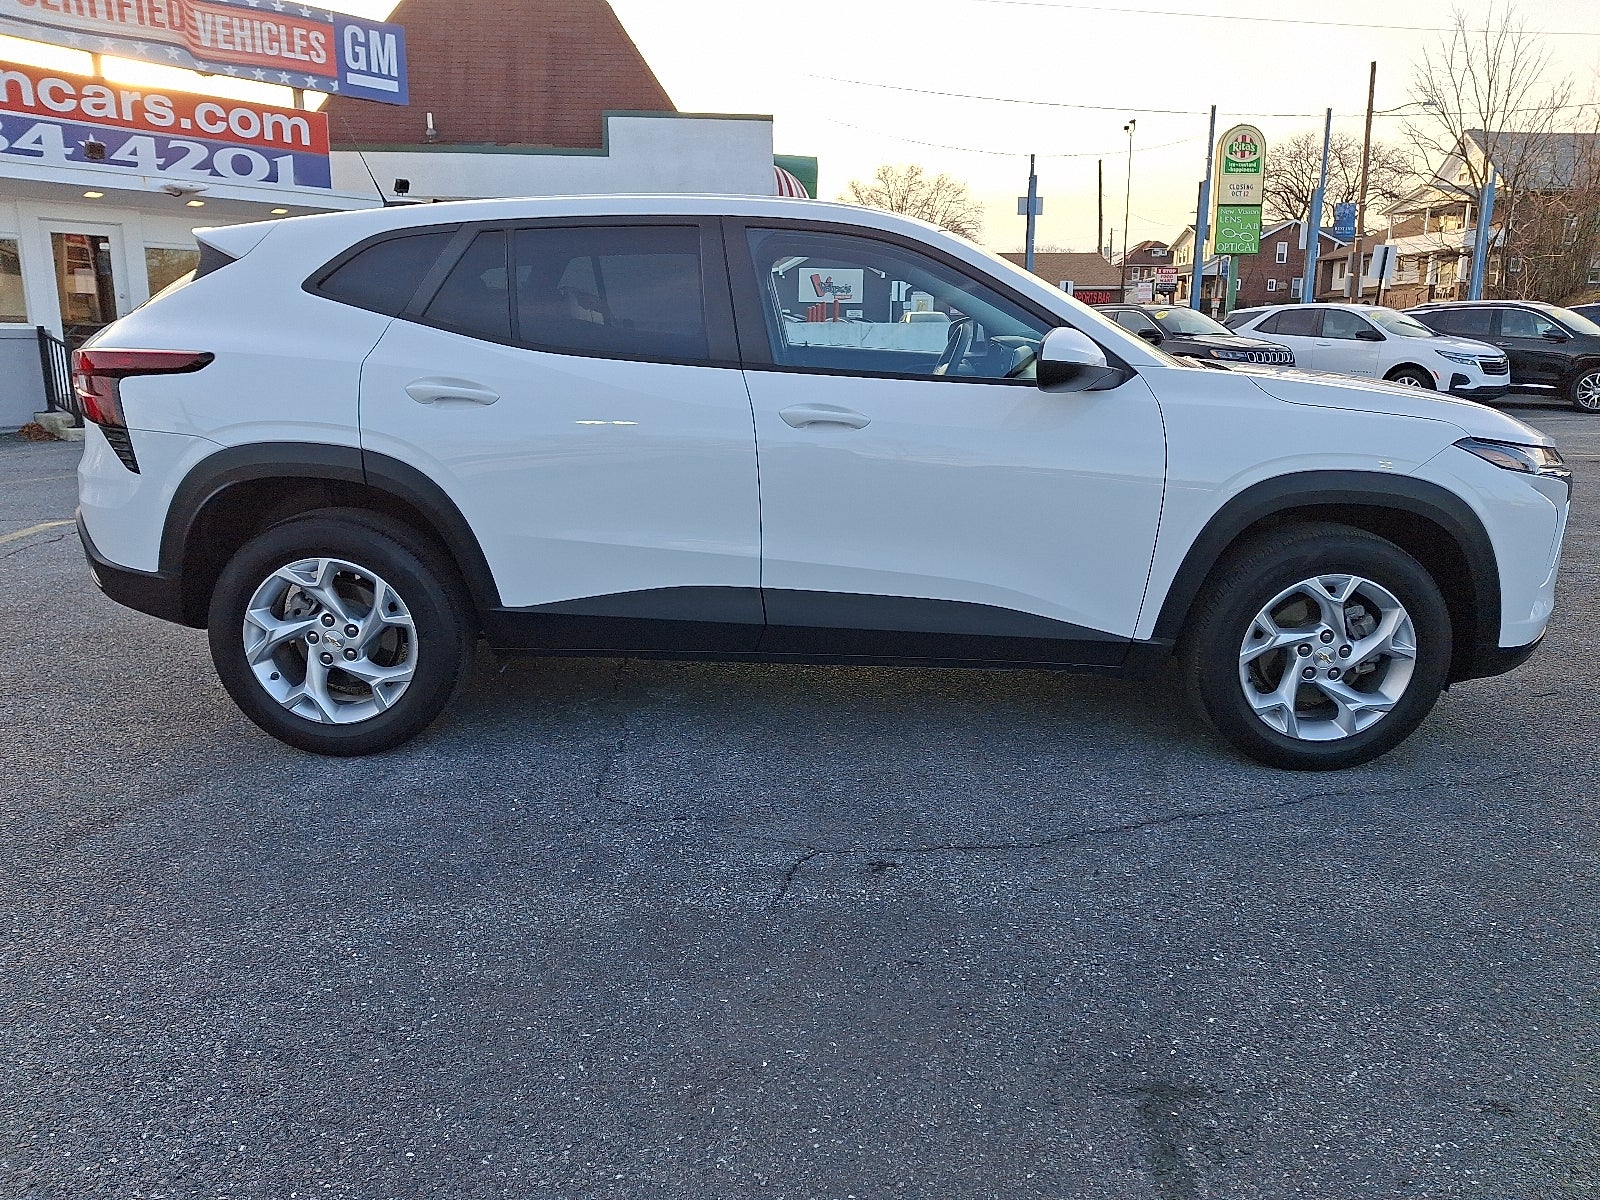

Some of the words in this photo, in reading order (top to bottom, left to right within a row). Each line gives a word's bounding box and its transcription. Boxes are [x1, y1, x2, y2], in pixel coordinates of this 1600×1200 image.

[194, 10, 327, 64] VEHICLES
[343, 24, 399, 77] GM
[0, 69, 310, 146] ncars.com
[110, 135, 298, 188] 4201
[1216, 242, 1257, 251] OPTICAL
[1240, 222, 1259, 230] LAB
[1074, 291, 1097, 304] SPORTS
[1098, 291, 1110, 304] BAR
